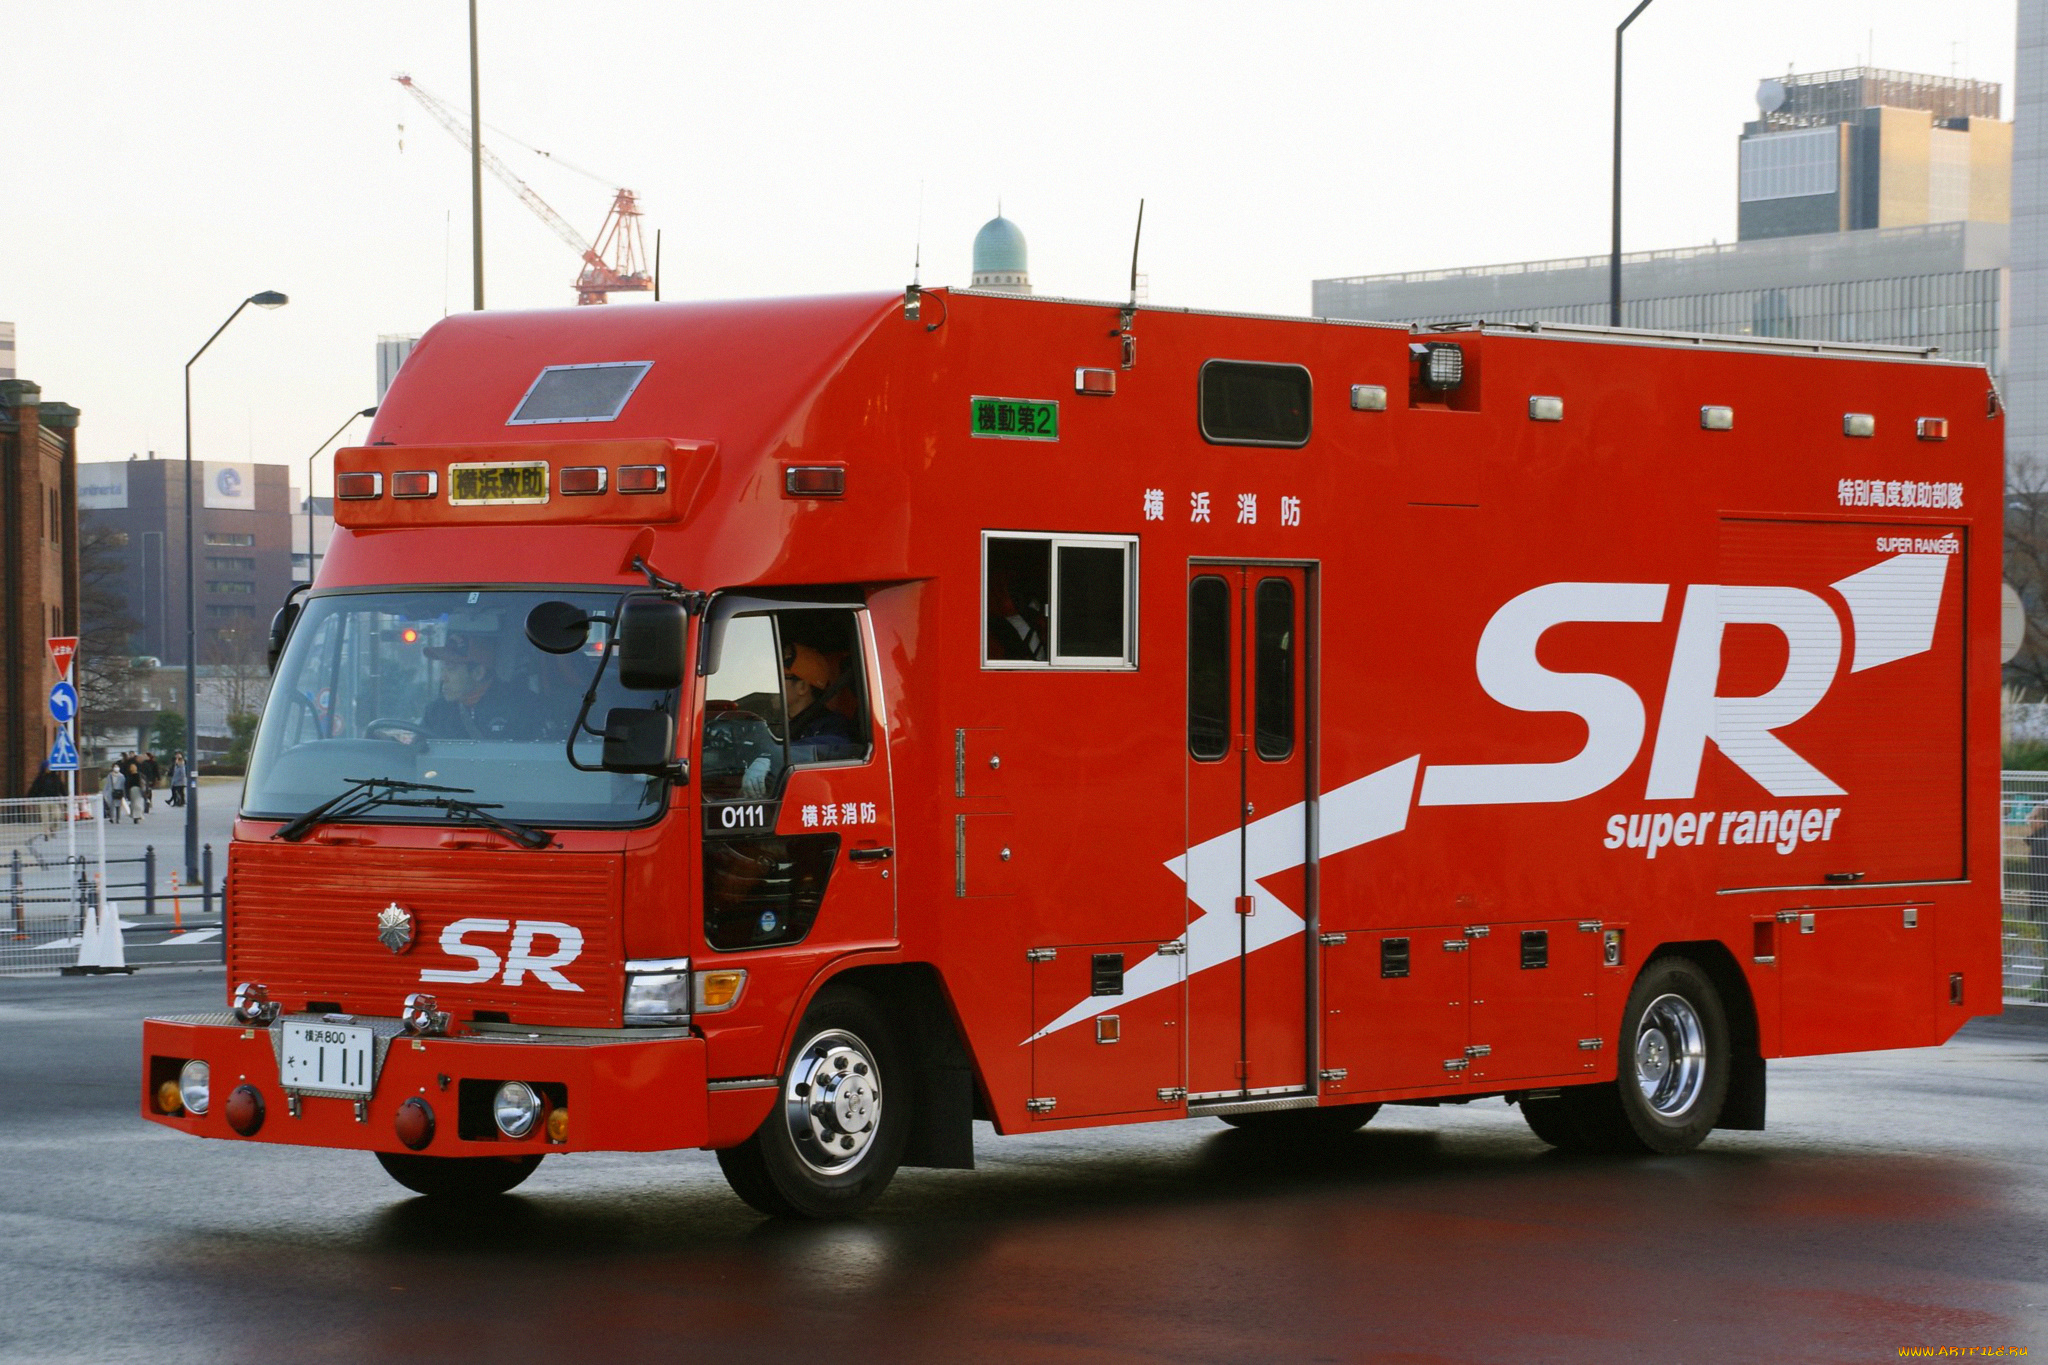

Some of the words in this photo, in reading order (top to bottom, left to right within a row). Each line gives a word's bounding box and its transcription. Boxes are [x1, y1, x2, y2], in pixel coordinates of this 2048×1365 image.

[978, 404, 1052, 434] 機動第2
[457, 468, 543, 499] 横浜救助
[1838, 479, 1963, 509] 特別高度救助部隊
[1876, 537, 1913, 553] SUPER
[1914, 538, 1960, 554] RANGER
[1418, 581, 1849, 807] SR
[721, 805, 765, 828] 0111
[801, 802, 877, 827] 横浜消防
[1603, 811, 1716, 859] super
[1718, 807, 1841, 855] ranger
[419, 917, 585, 992] SR
